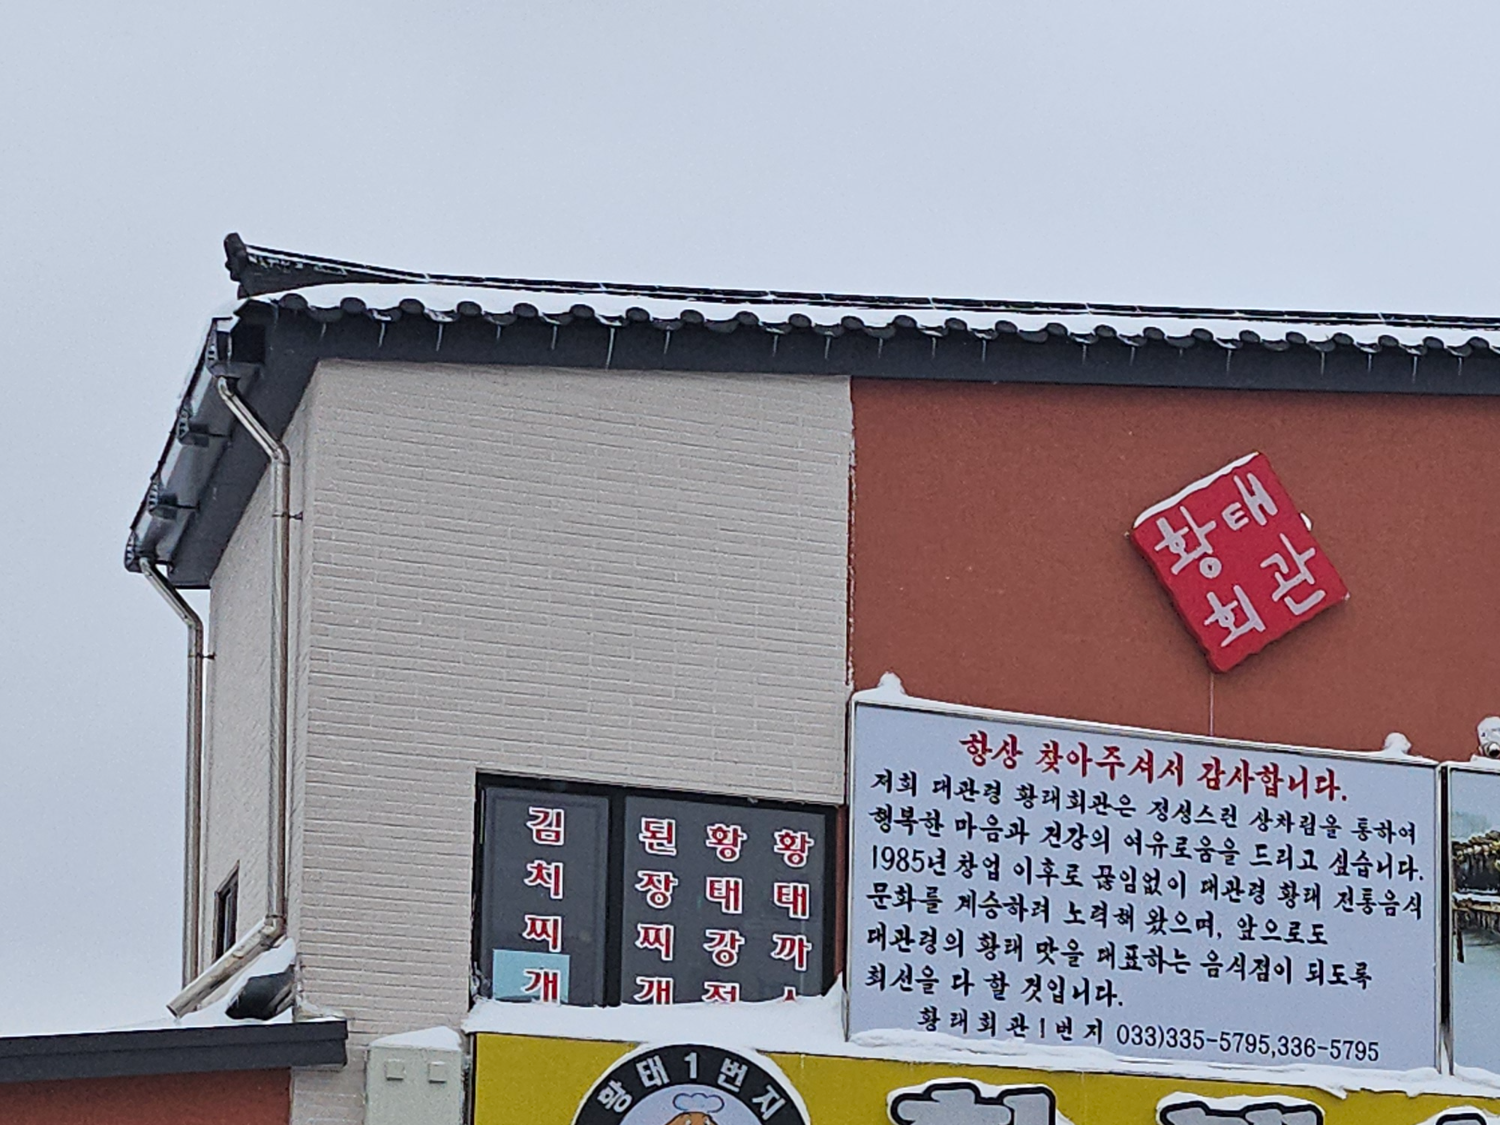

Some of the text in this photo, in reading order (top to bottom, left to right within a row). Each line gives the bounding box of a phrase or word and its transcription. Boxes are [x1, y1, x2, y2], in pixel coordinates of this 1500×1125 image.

[1154, 472, 1279, 579] 황태
[1203, 533, 1326, 648] 회관
[959, 730, 1346, 801] 항상 찾아주셔서 감사합니다.
[869, 804, 1423, 881] 행복한 마음과 건강의 여유로움을 드리고 싶습니다.
[932, 774, 1001, 805] 대관령
[1014, 783, 1136, 817] 황태회관은
[1147, 797, 1237, 828] 정성스런
[1249, 807, 1342, 839] 상차림을
[1351, 818, 1415, 845] 통하여
[524, 807, 565, 1002] 김치찌개
[635, 817, 678, 1004] 된장찌개
[866, 883, 1328, 944] 문화를 계승하려 노력해 왔으며, 앞으로도
[873, 845, 946, 876] 1985년
[954, 851, 999, 881] 창업
[1014, 856, 1083, 887] 이후로
[1200, 873, 1264, 905] 대관령
[1278, 880, 1320, 911] 황태
[1334, 886, 1421, 920] 전통음식
[865, 963, 1122, 1007] 최선을 다 할 것입니다.
[867, 922, 1372, 990] 대관령의 황태 맛을 대표하는 음식점이 되도록
[597, 1052, 786, 1120] 황태1번지
